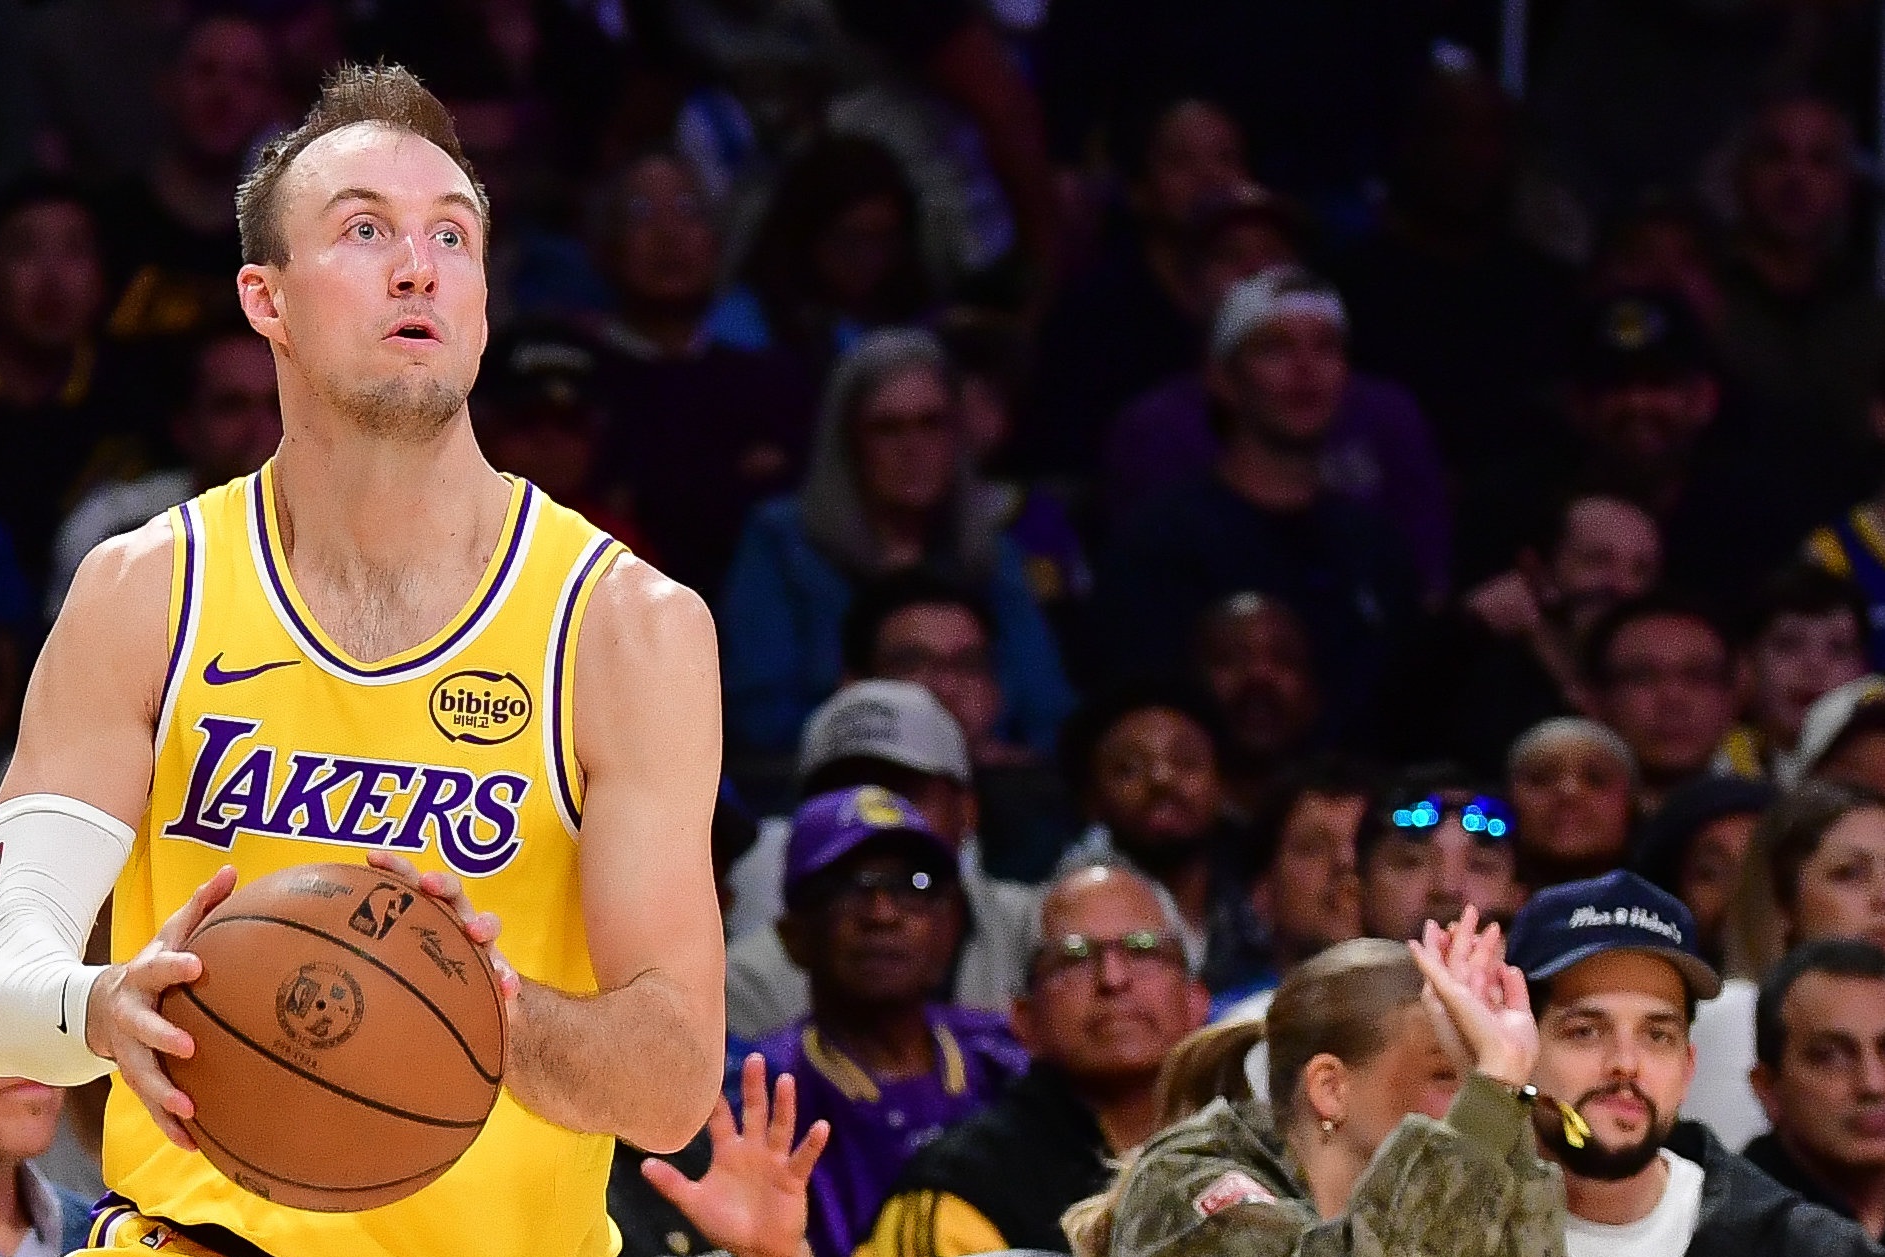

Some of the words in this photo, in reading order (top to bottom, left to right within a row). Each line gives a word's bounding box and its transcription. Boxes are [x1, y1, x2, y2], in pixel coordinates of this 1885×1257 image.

[440, 689, 526, 724] bibigo
[453, 714, 490, 728] 비비고
[160, 714, 533, 878] LAKERS
